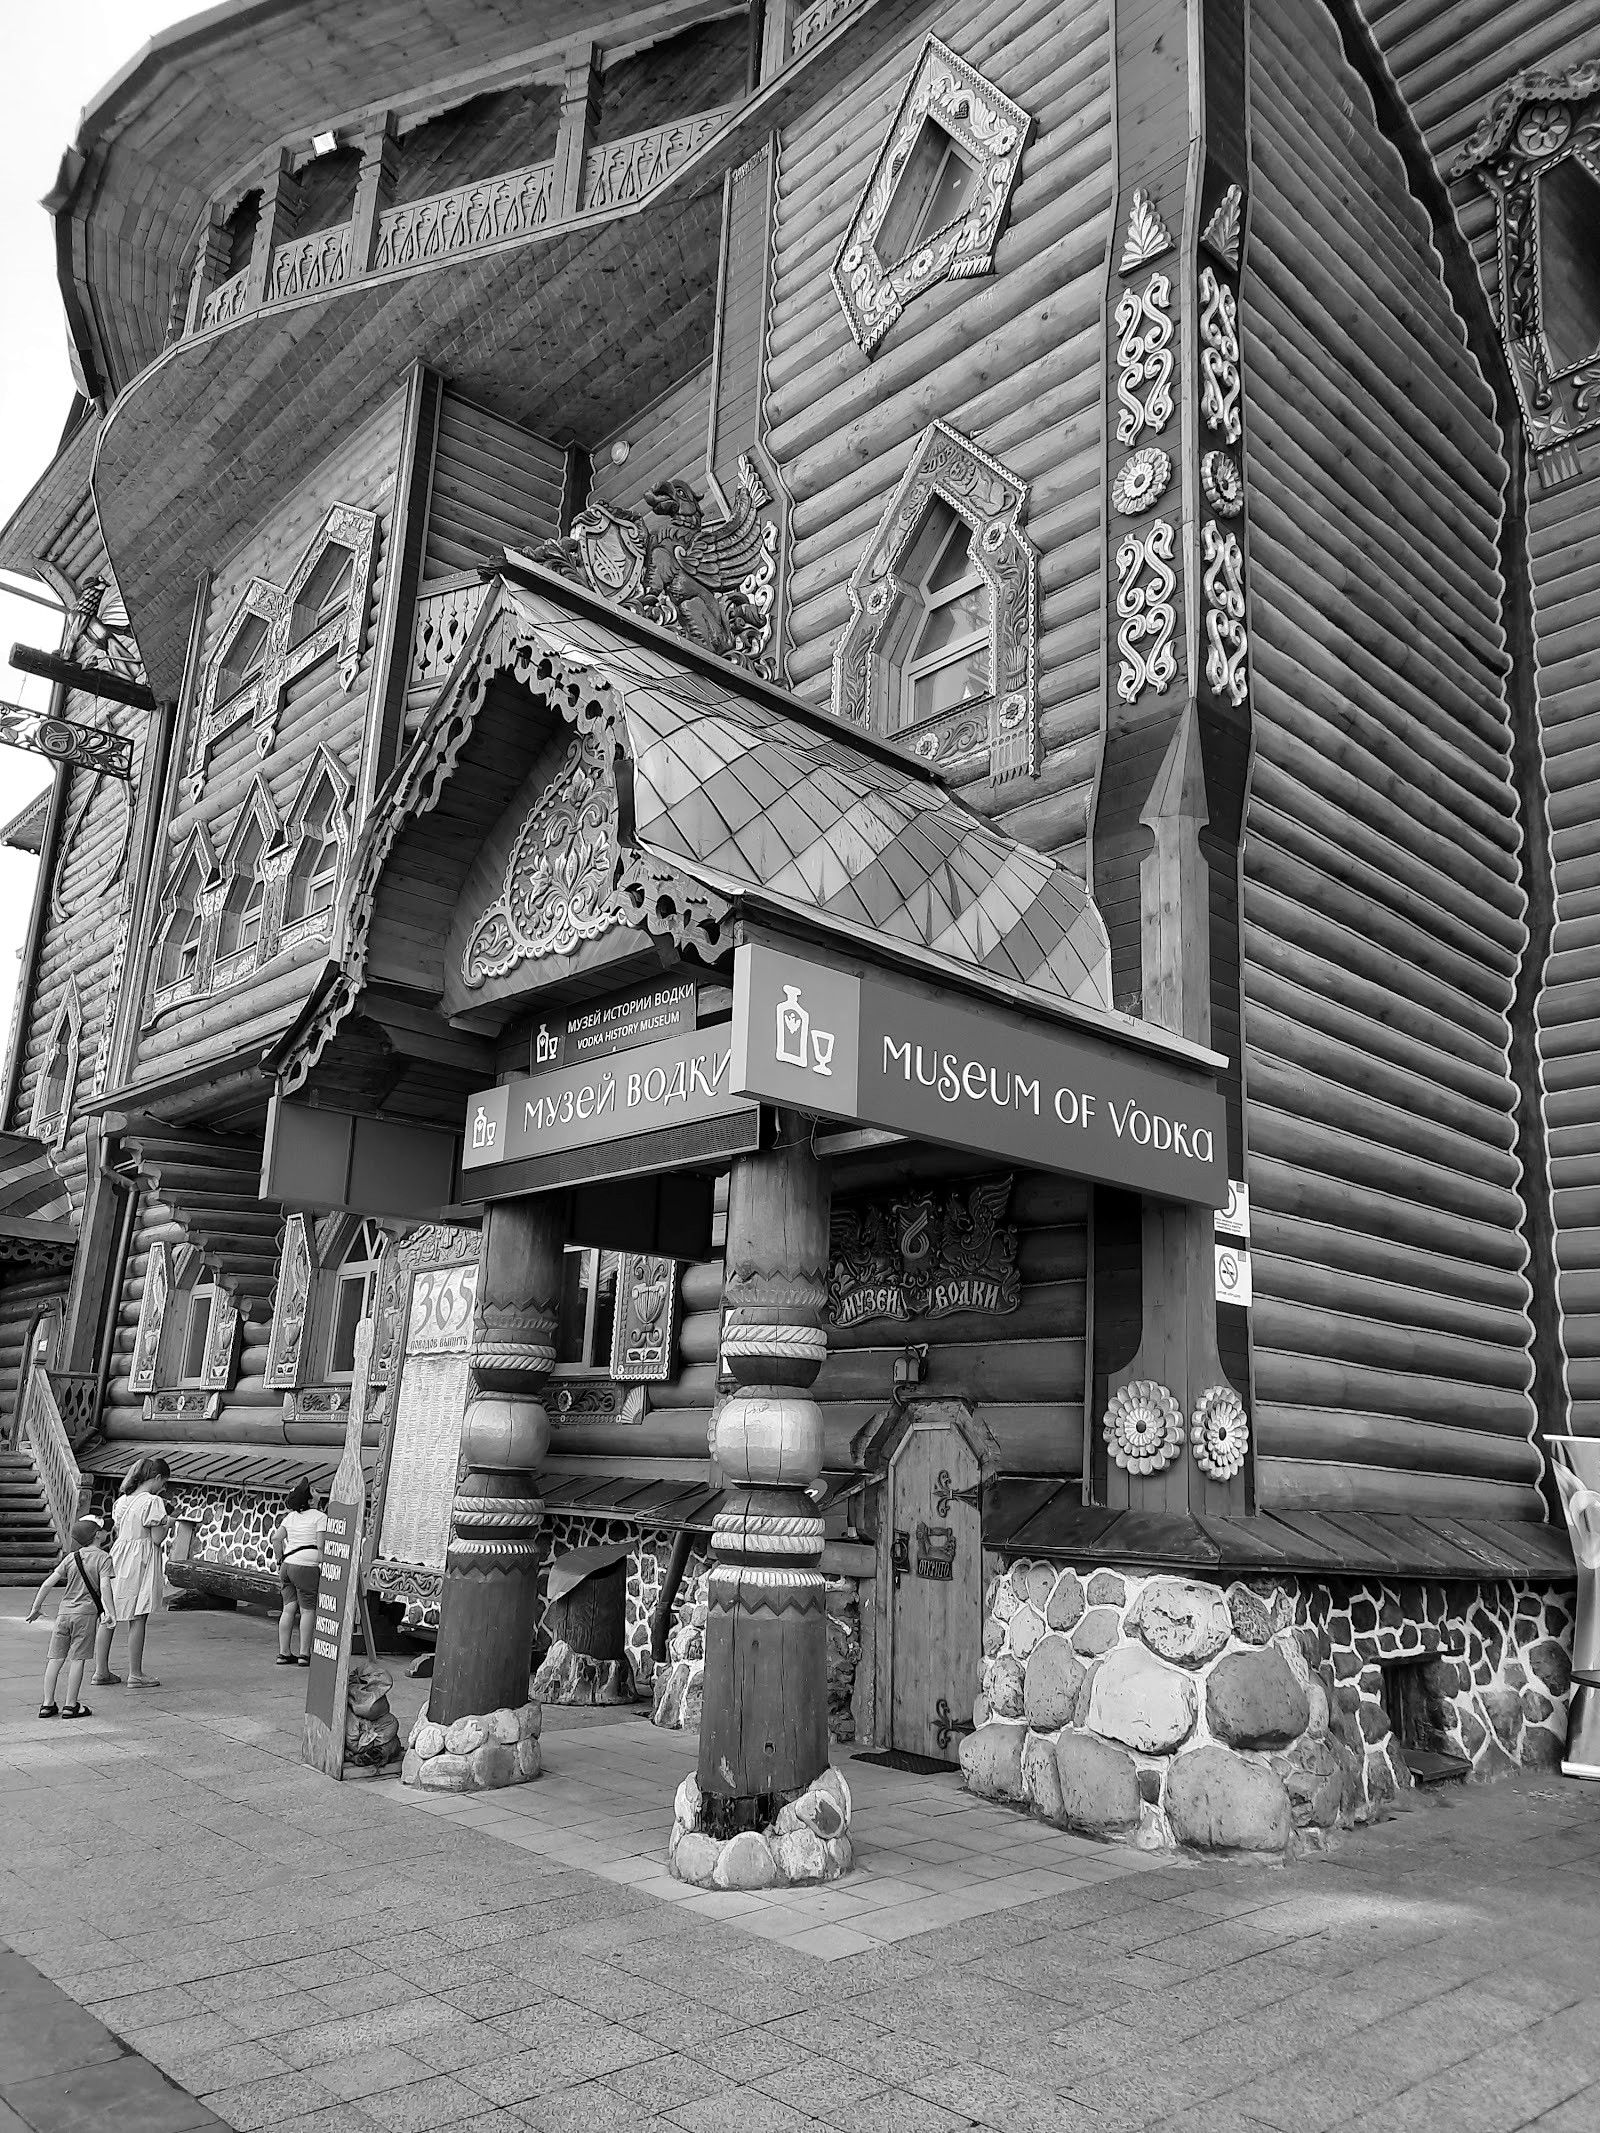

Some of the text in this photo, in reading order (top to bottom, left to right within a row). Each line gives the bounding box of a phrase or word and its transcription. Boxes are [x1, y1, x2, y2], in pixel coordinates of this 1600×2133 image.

[567, 982, 694, 1034] МУЗЕЙ ИСТОРИИ ВОДКИ
[576, 1010, 680, 1050] VODKA HISTORY MUSEUM
[1053, 1087, 1097, 1129] OF
[414, 1264, 478, 1336] 365
[841, 1279, 1001, 1324] МУЗЕЙ ВОДКИ
[326, 1516, 347, 1536] МУЗЕЙ
[323, 1539, 350, 1560] ИСТОРИИ
[321, 1561, 342, 1582] ВОДКИ
[318, 1592, 337, 1613] VODKA
[315, 1615, 340, 1637] HISTORY
[312, 1637, 338, 1661] MUSEUM
